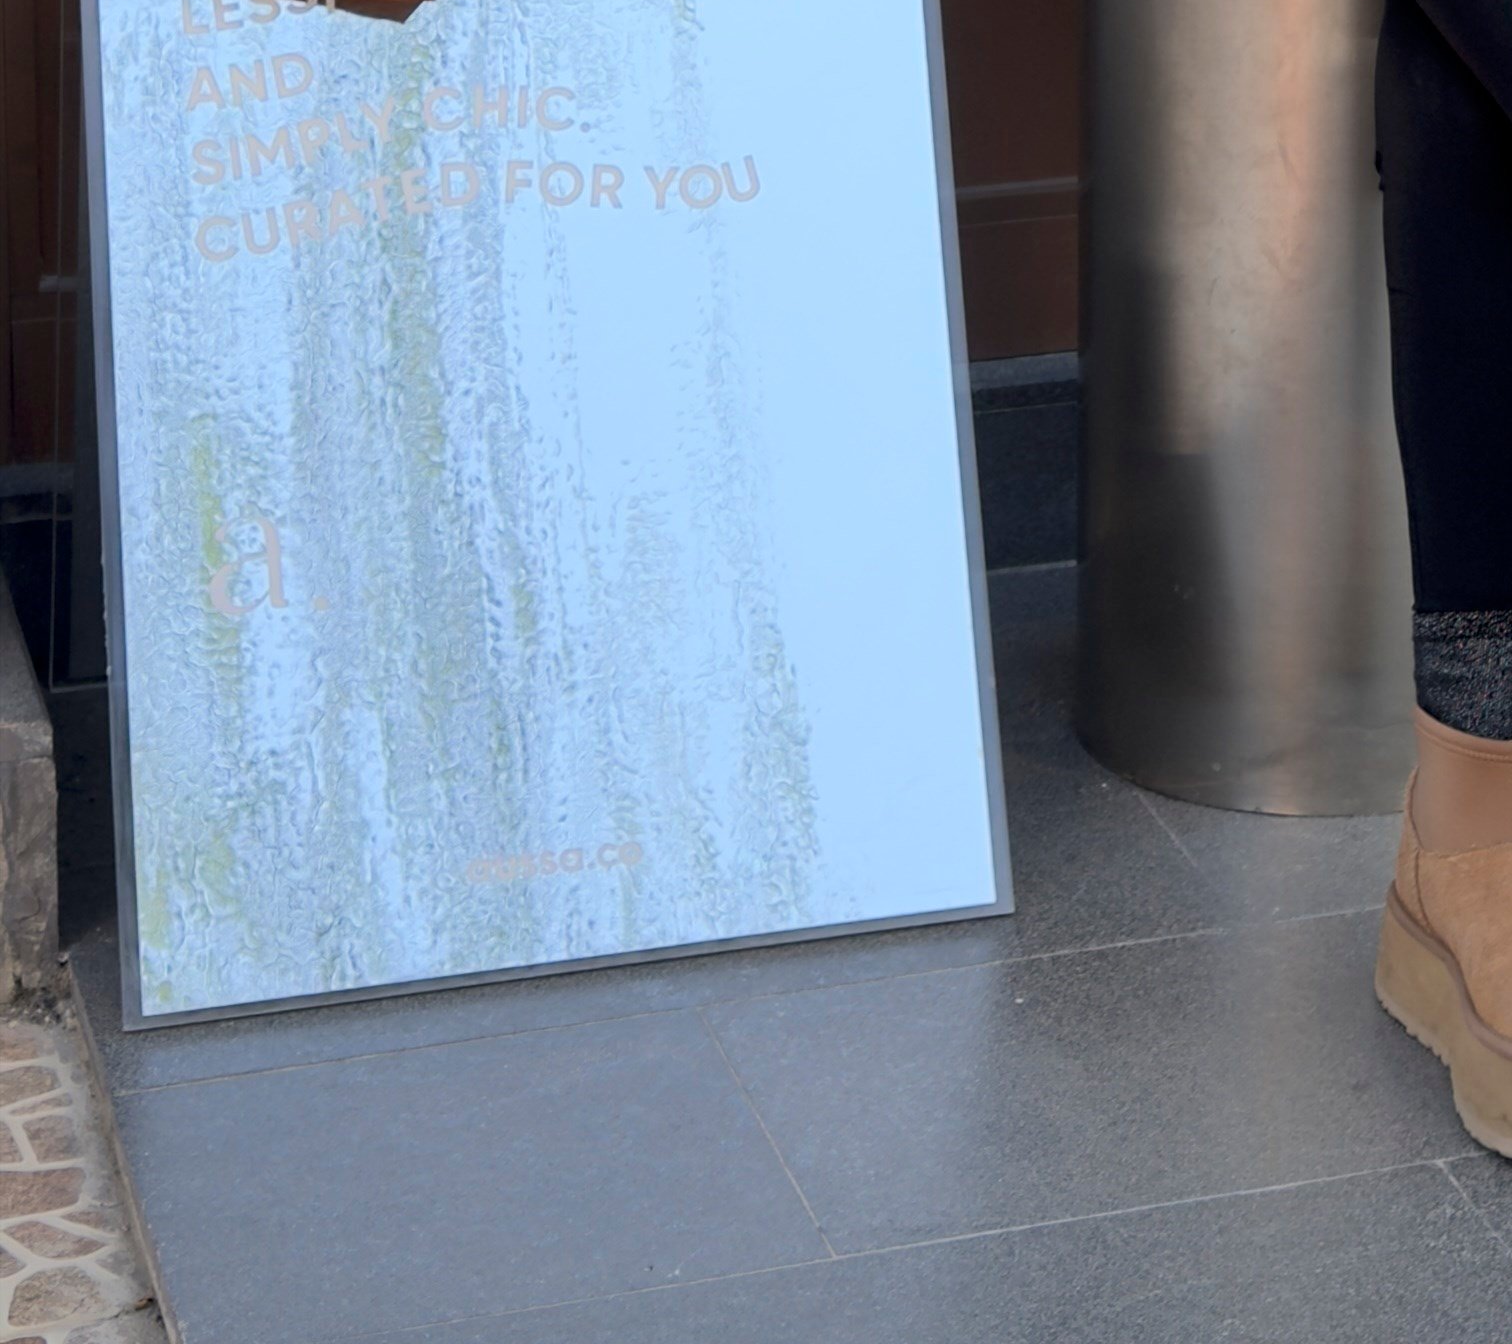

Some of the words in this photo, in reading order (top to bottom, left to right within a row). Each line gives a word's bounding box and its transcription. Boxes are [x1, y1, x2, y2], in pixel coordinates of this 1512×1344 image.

[186, 52, 315, 112] AND
[192, 96, 397, 186] SIMPLY
[422, 83, 592, 133] CHIC.
[194, 161, 480, 262] CURATED
[504, 159, 626, 210] FOR
[643, 154, 761, 211] YOU
